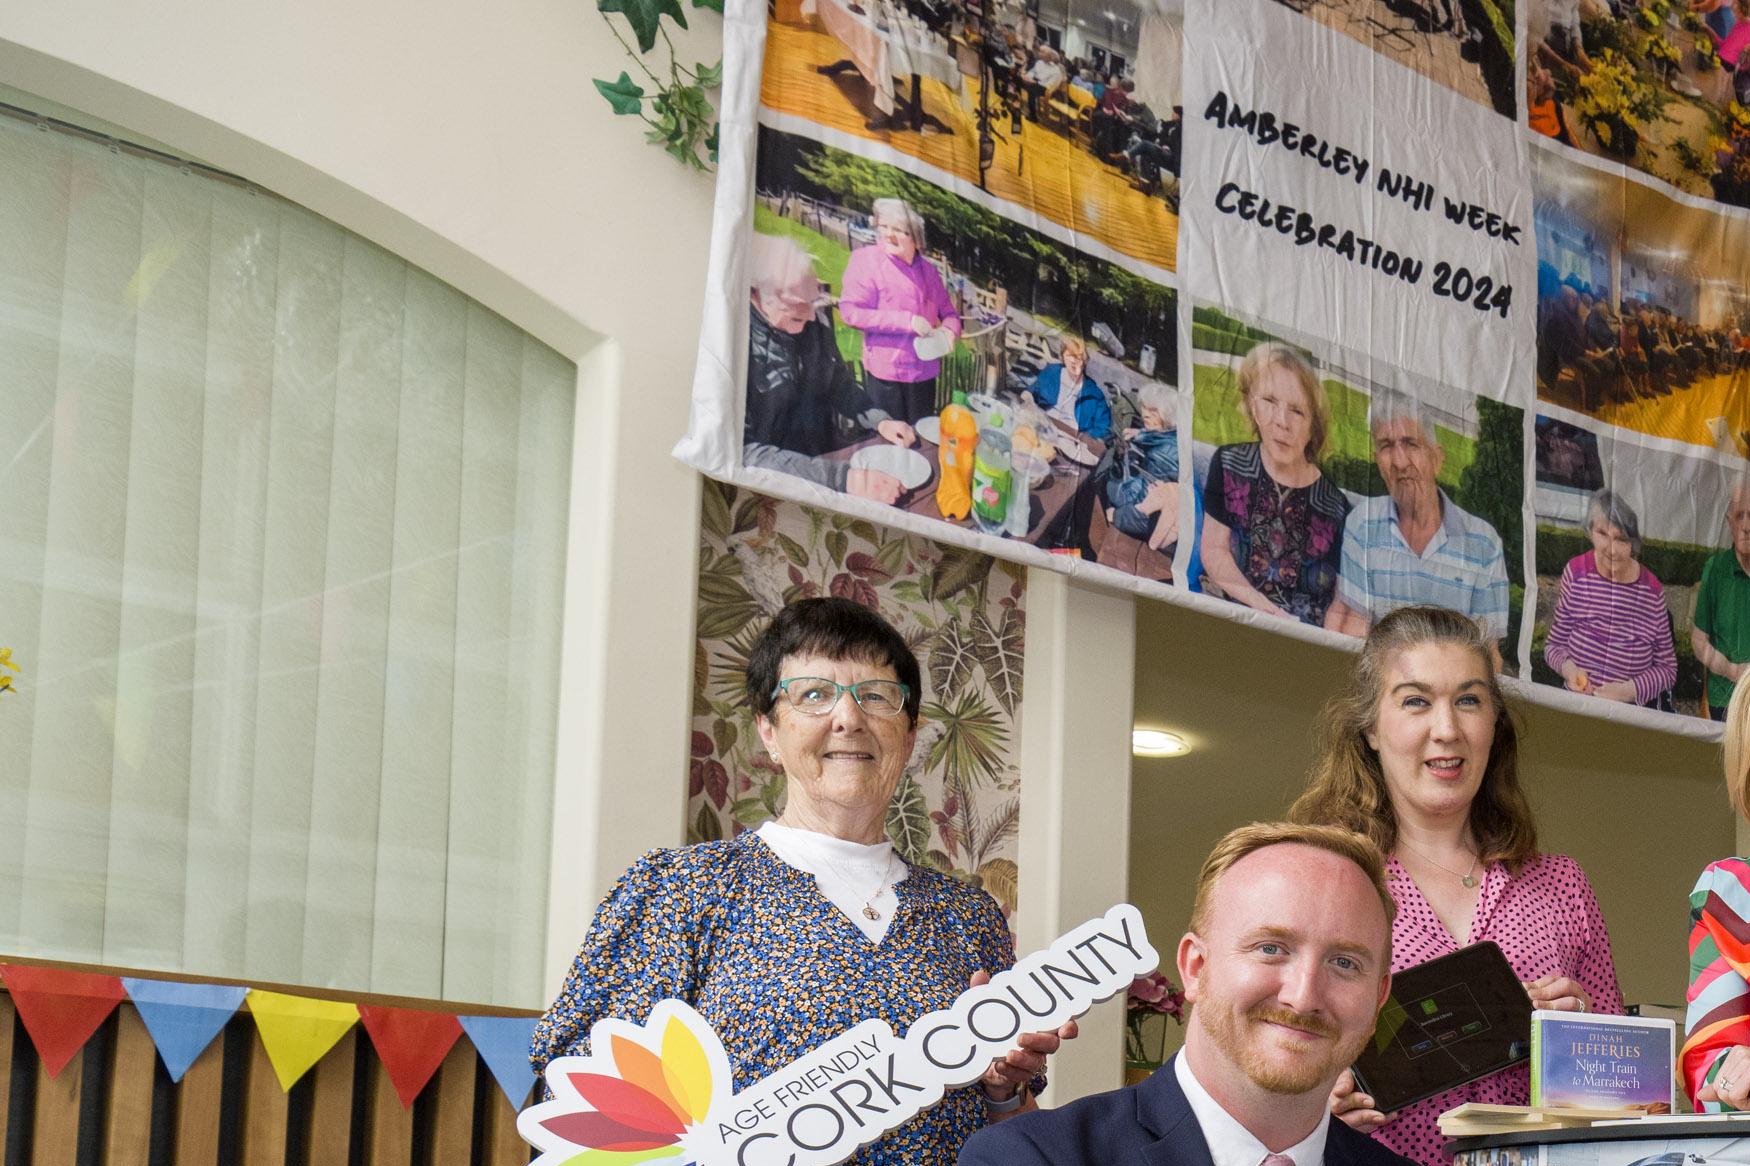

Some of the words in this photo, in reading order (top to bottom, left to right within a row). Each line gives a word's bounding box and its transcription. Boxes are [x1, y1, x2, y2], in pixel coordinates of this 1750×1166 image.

[1204, 91, 1369, 184] AMBERLEY
[1377, 168, 1434, 211] NHI
[1443, 197, 1522, 246] WEEK
[1215, 182, 1423, 284] CELEBRATION
[1433, 261, 1512, 319] 2024
[922, 917, 1144, 1071] COUNTY
[1571, 1042, 1640, 1059] JEFFERIES
[1576, 1059, 1606, 1074] Night
[1609, 1061, 1637, 1074] Train
[1589, 1033, 1623, 1043] DINAH
[717, 1107, 776, 1145] AGE
[778, 1033, 882, 1110] FRIENDLY
[1572, 1077, 1581, 1086] to
[1583, 1075, 1640, 1089] Marrakech
